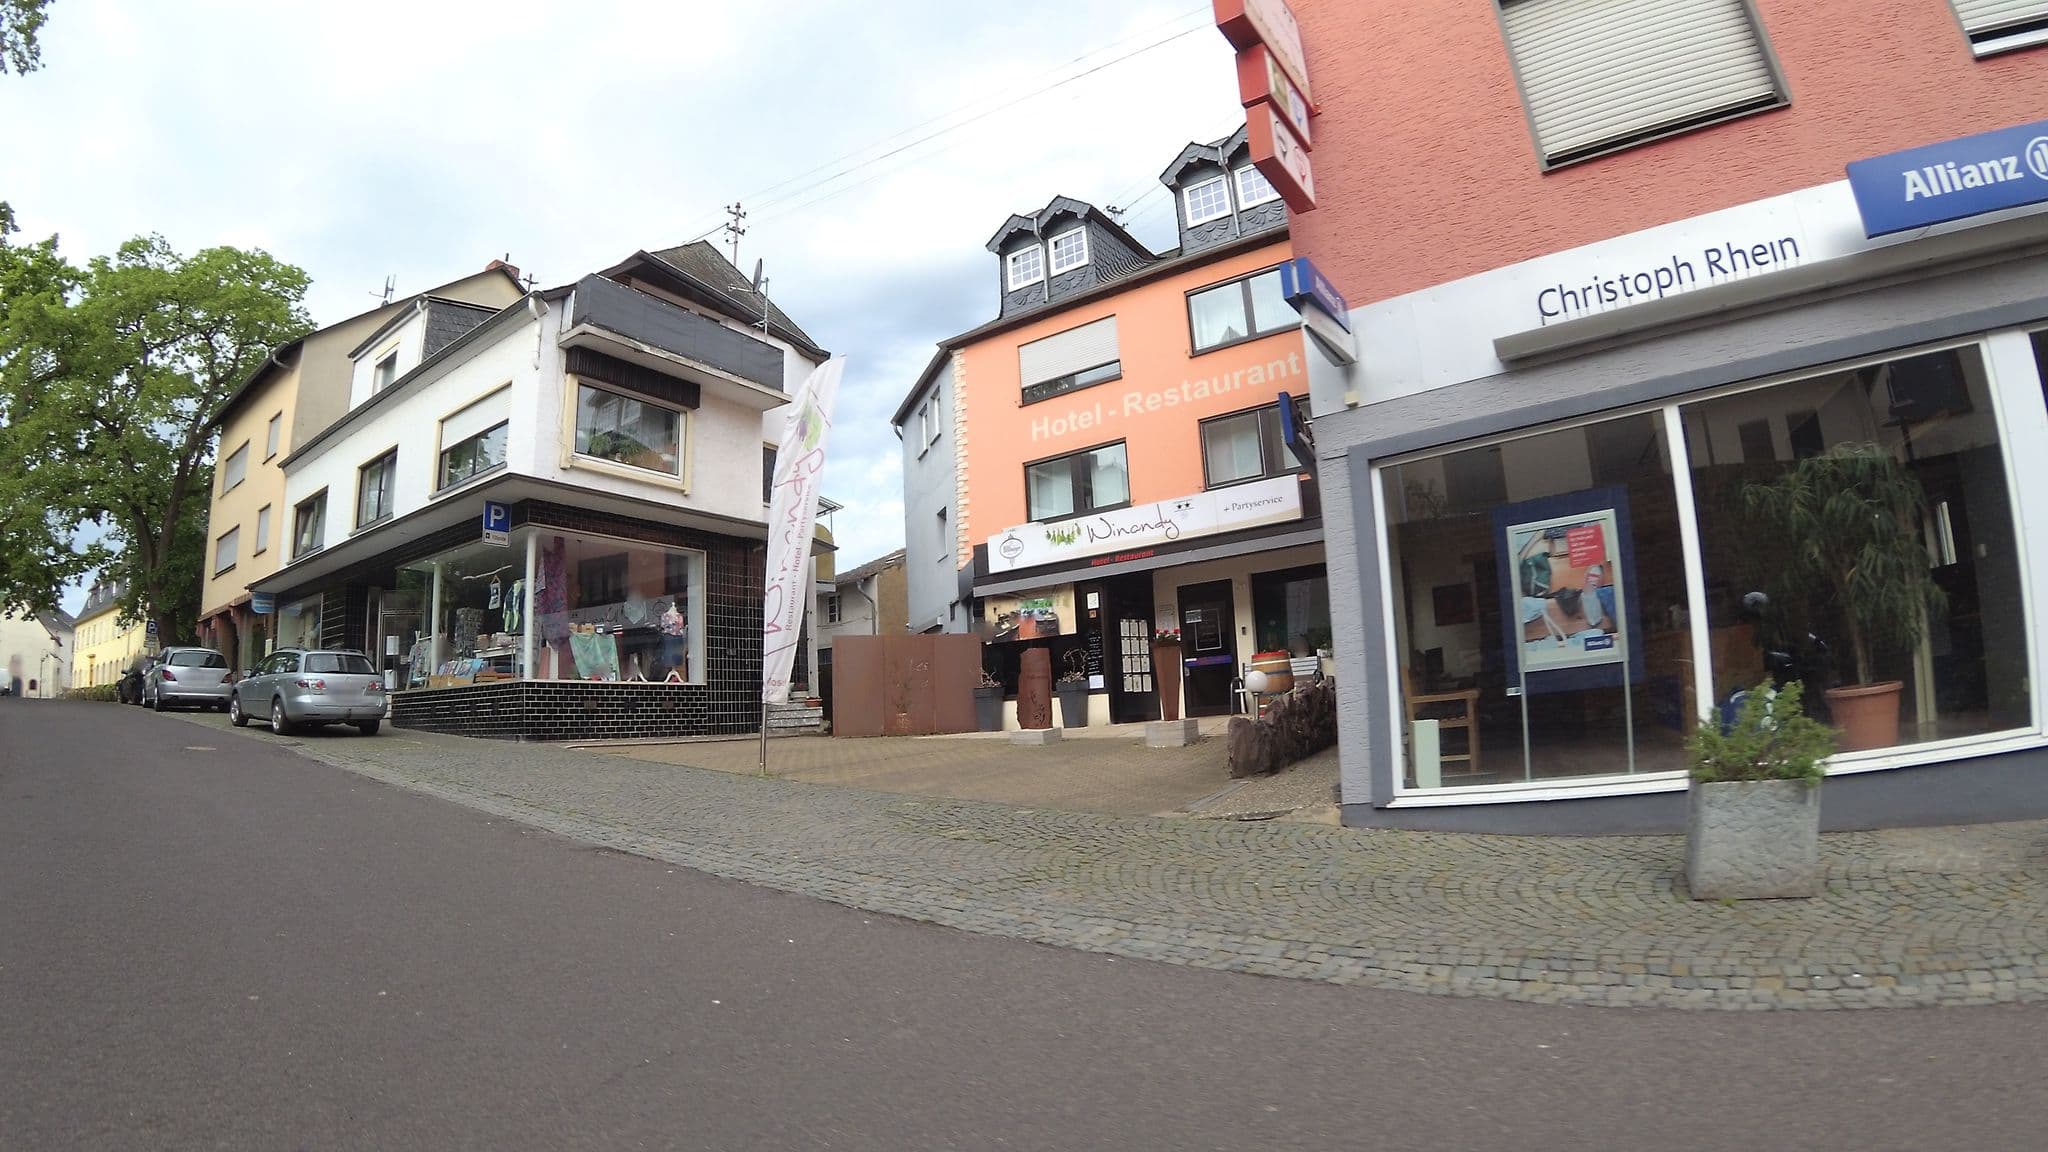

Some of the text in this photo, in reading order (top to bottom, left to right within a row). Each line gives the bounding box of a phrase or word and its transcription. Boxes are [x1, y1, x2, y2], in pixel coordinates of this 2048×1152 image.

[1903, 155, 2024, 202] Allianz
[1538, 255, 1697, 318] Christoph
[1031, 402, 1102, 442] Hotel
[1122, 351, 1302, 418] Restaurant
[489, 505, 505, 528] P
[1086, 503, 1180, 544] Winandy
[1231, 496, 1284, 512] Partyservice
[784, 581, 798, 631] Restaurant
[792, 547, 803, 572] Hotel
